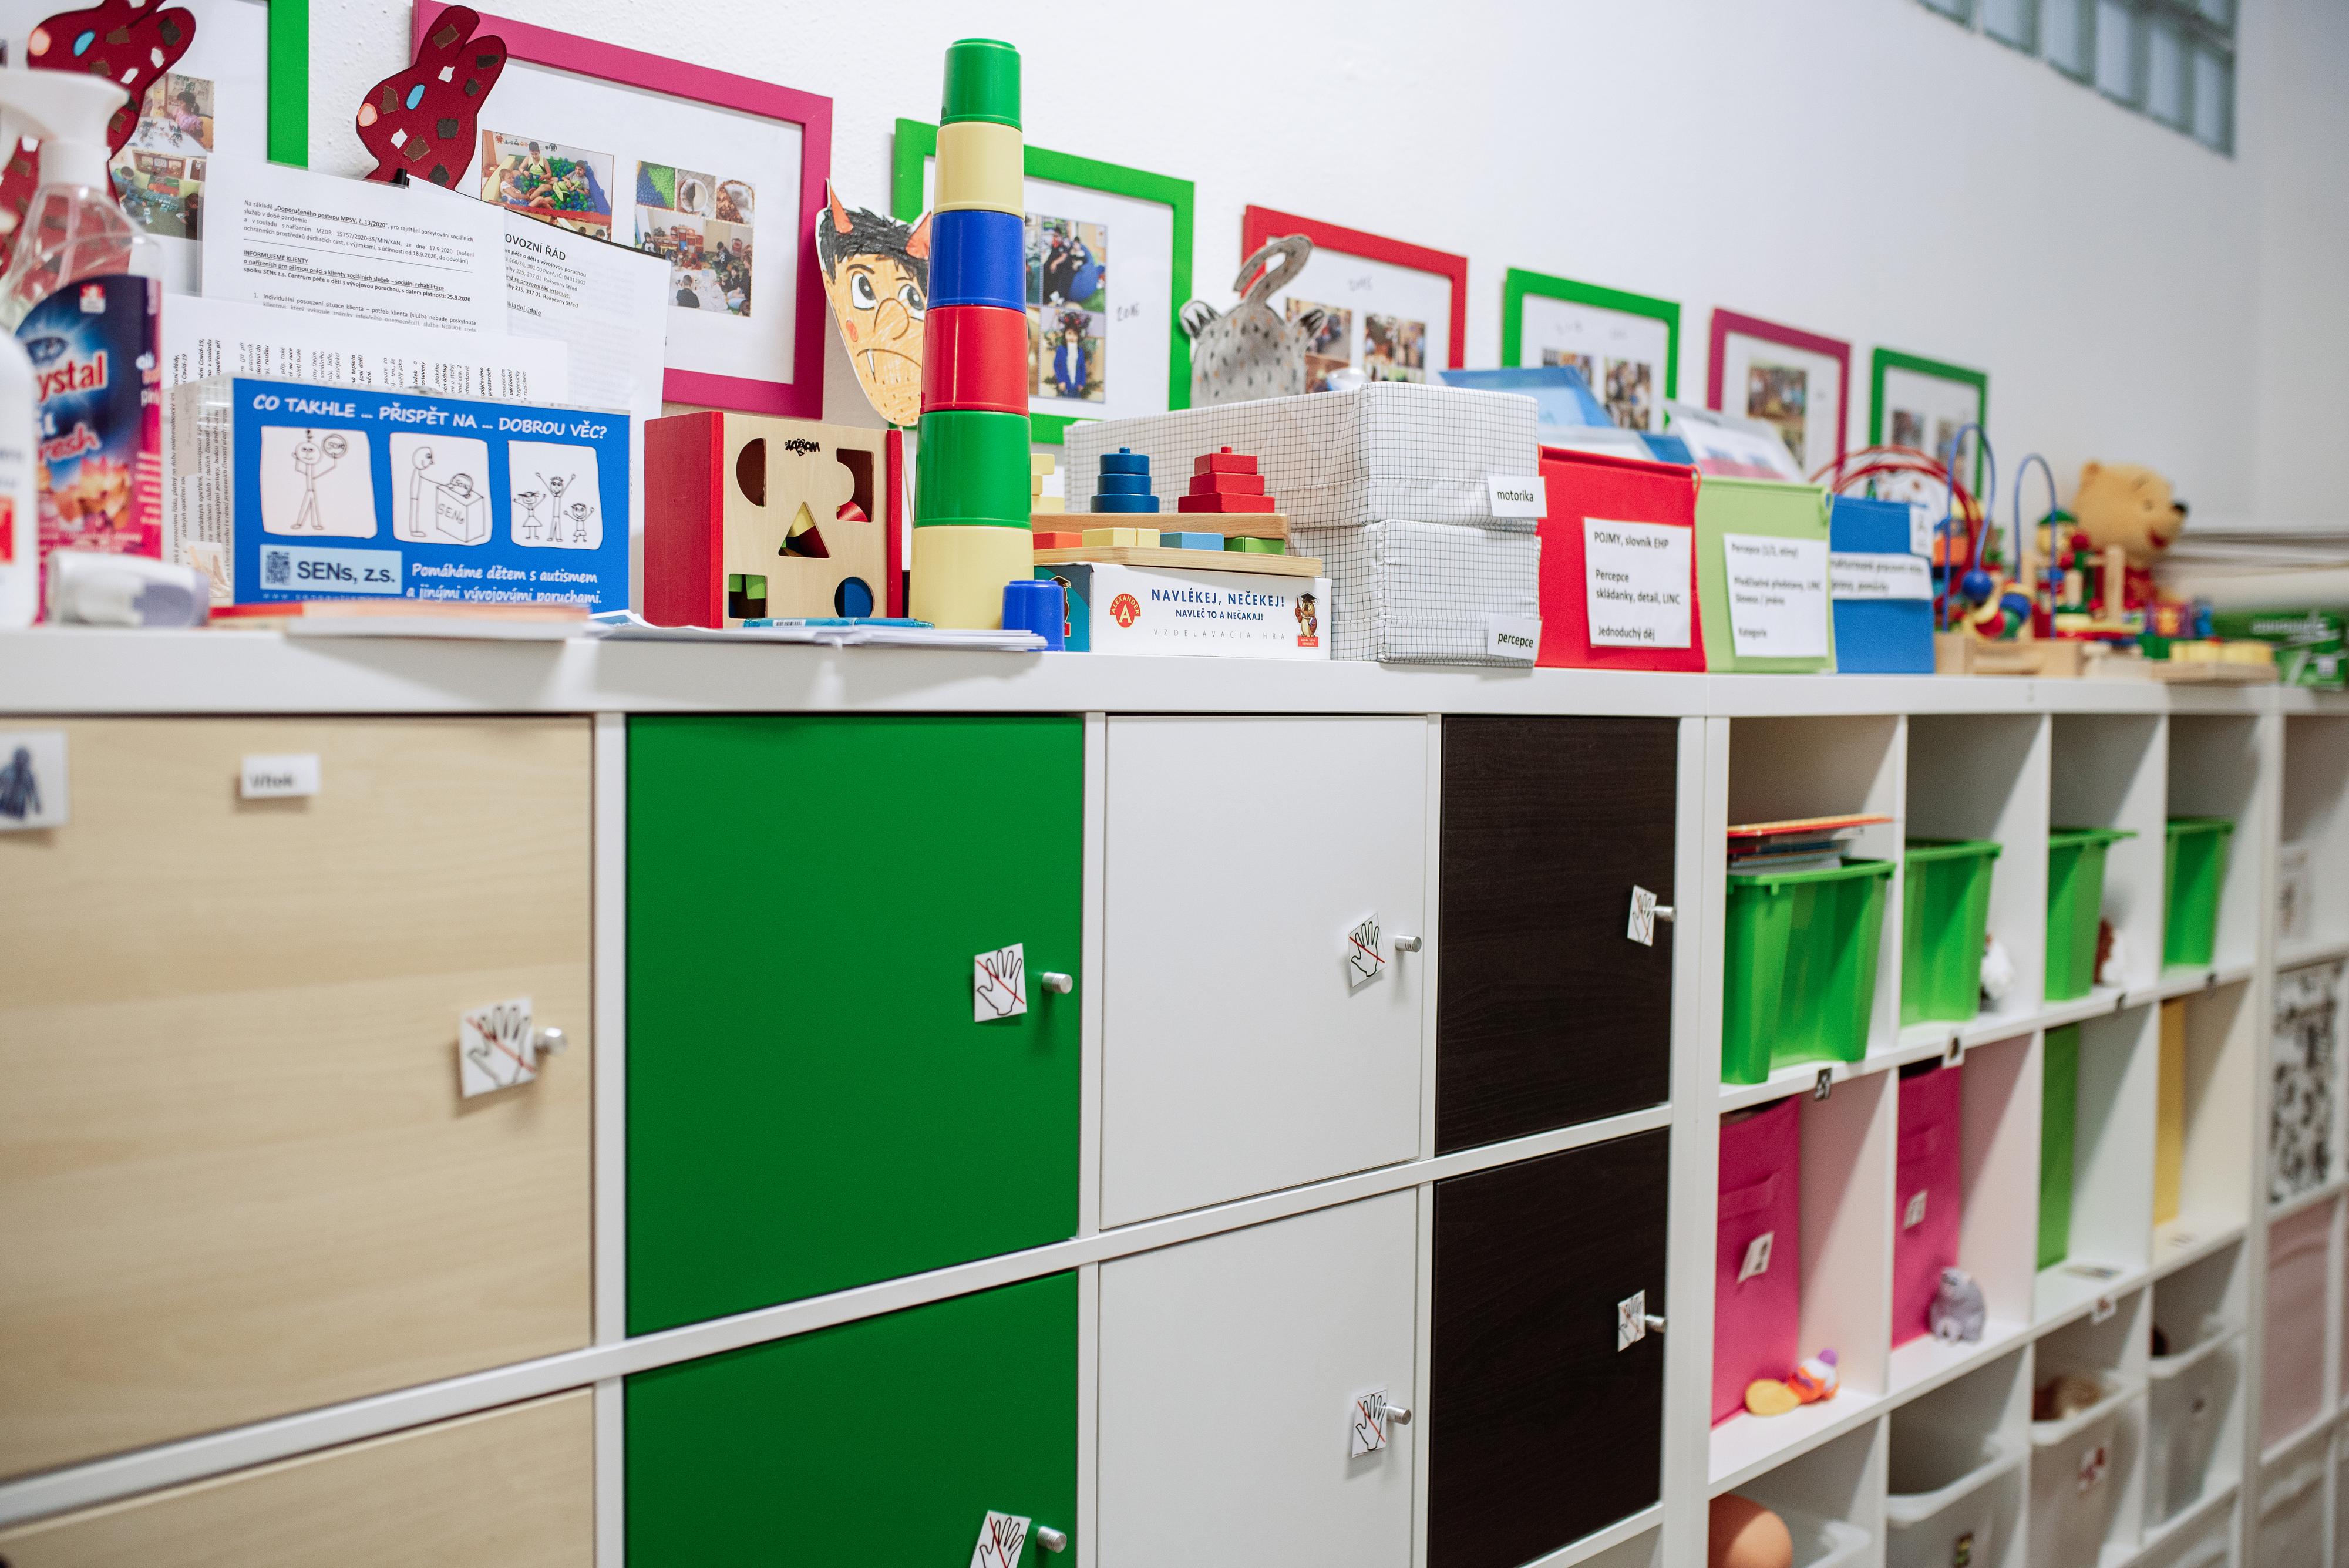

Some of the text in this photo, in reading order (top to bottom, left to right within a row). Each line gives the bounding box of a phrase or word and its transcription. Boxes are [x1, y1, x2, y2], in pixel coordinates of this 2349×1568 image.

[243, 250, 285, 260] INFORMUJEME
[504, 234, 542, 253] OVOZNÍ
[544, 245, 566, 260] ŘÁD
[36, 352, 105, 403] ystal
[253, 393, 280, 411] CO
[285, 396, 356, 418] TAKHLE
[379, 401, 449, 427] PŘISPĚT
[453, 413, 477, 429] NA
[499, 418, 564, 436] DOBROU
[570, 421, 607, 439] VĚC?
[1497, 490, 1534, 502] motorika
[1594, 532, 1669, 549] POJMY, slovník EHP
[297, 561, 395, 584] SENs, z.s.
[412, 562, 597, 583] Pomáháme dětem s autismem
[1596, 569, 1629, 584] Percepce
[406, 587, 415, 598] a
[419, 584, 460, 603] jinými
[463, 586, 533, 603] vývojovými
[537, 587, 602, 604] poruchami.
[1152, 587, 1284, 607] NAVLÉKEJ, NEČEKEJ!
[1596, 588, 1635, 604] skládanky,
[1638, 591, 1661, 605] detail,
[1110, 594, 1140, 615] ALEXANDER
[1118, 604, 1132, 623] A
[1176, 608, 1205, 618] NAVLEČ
[1208, 610, 1217, 618] TO
[1227, 610, 1263, 621] NEČAKAJ!
[1153, 628, 1251, 639] VZDELÁVACIA
[1498, 632, 1534, 648] percepce
[1598, 625, 1656, 641] Jednoduchý děj
